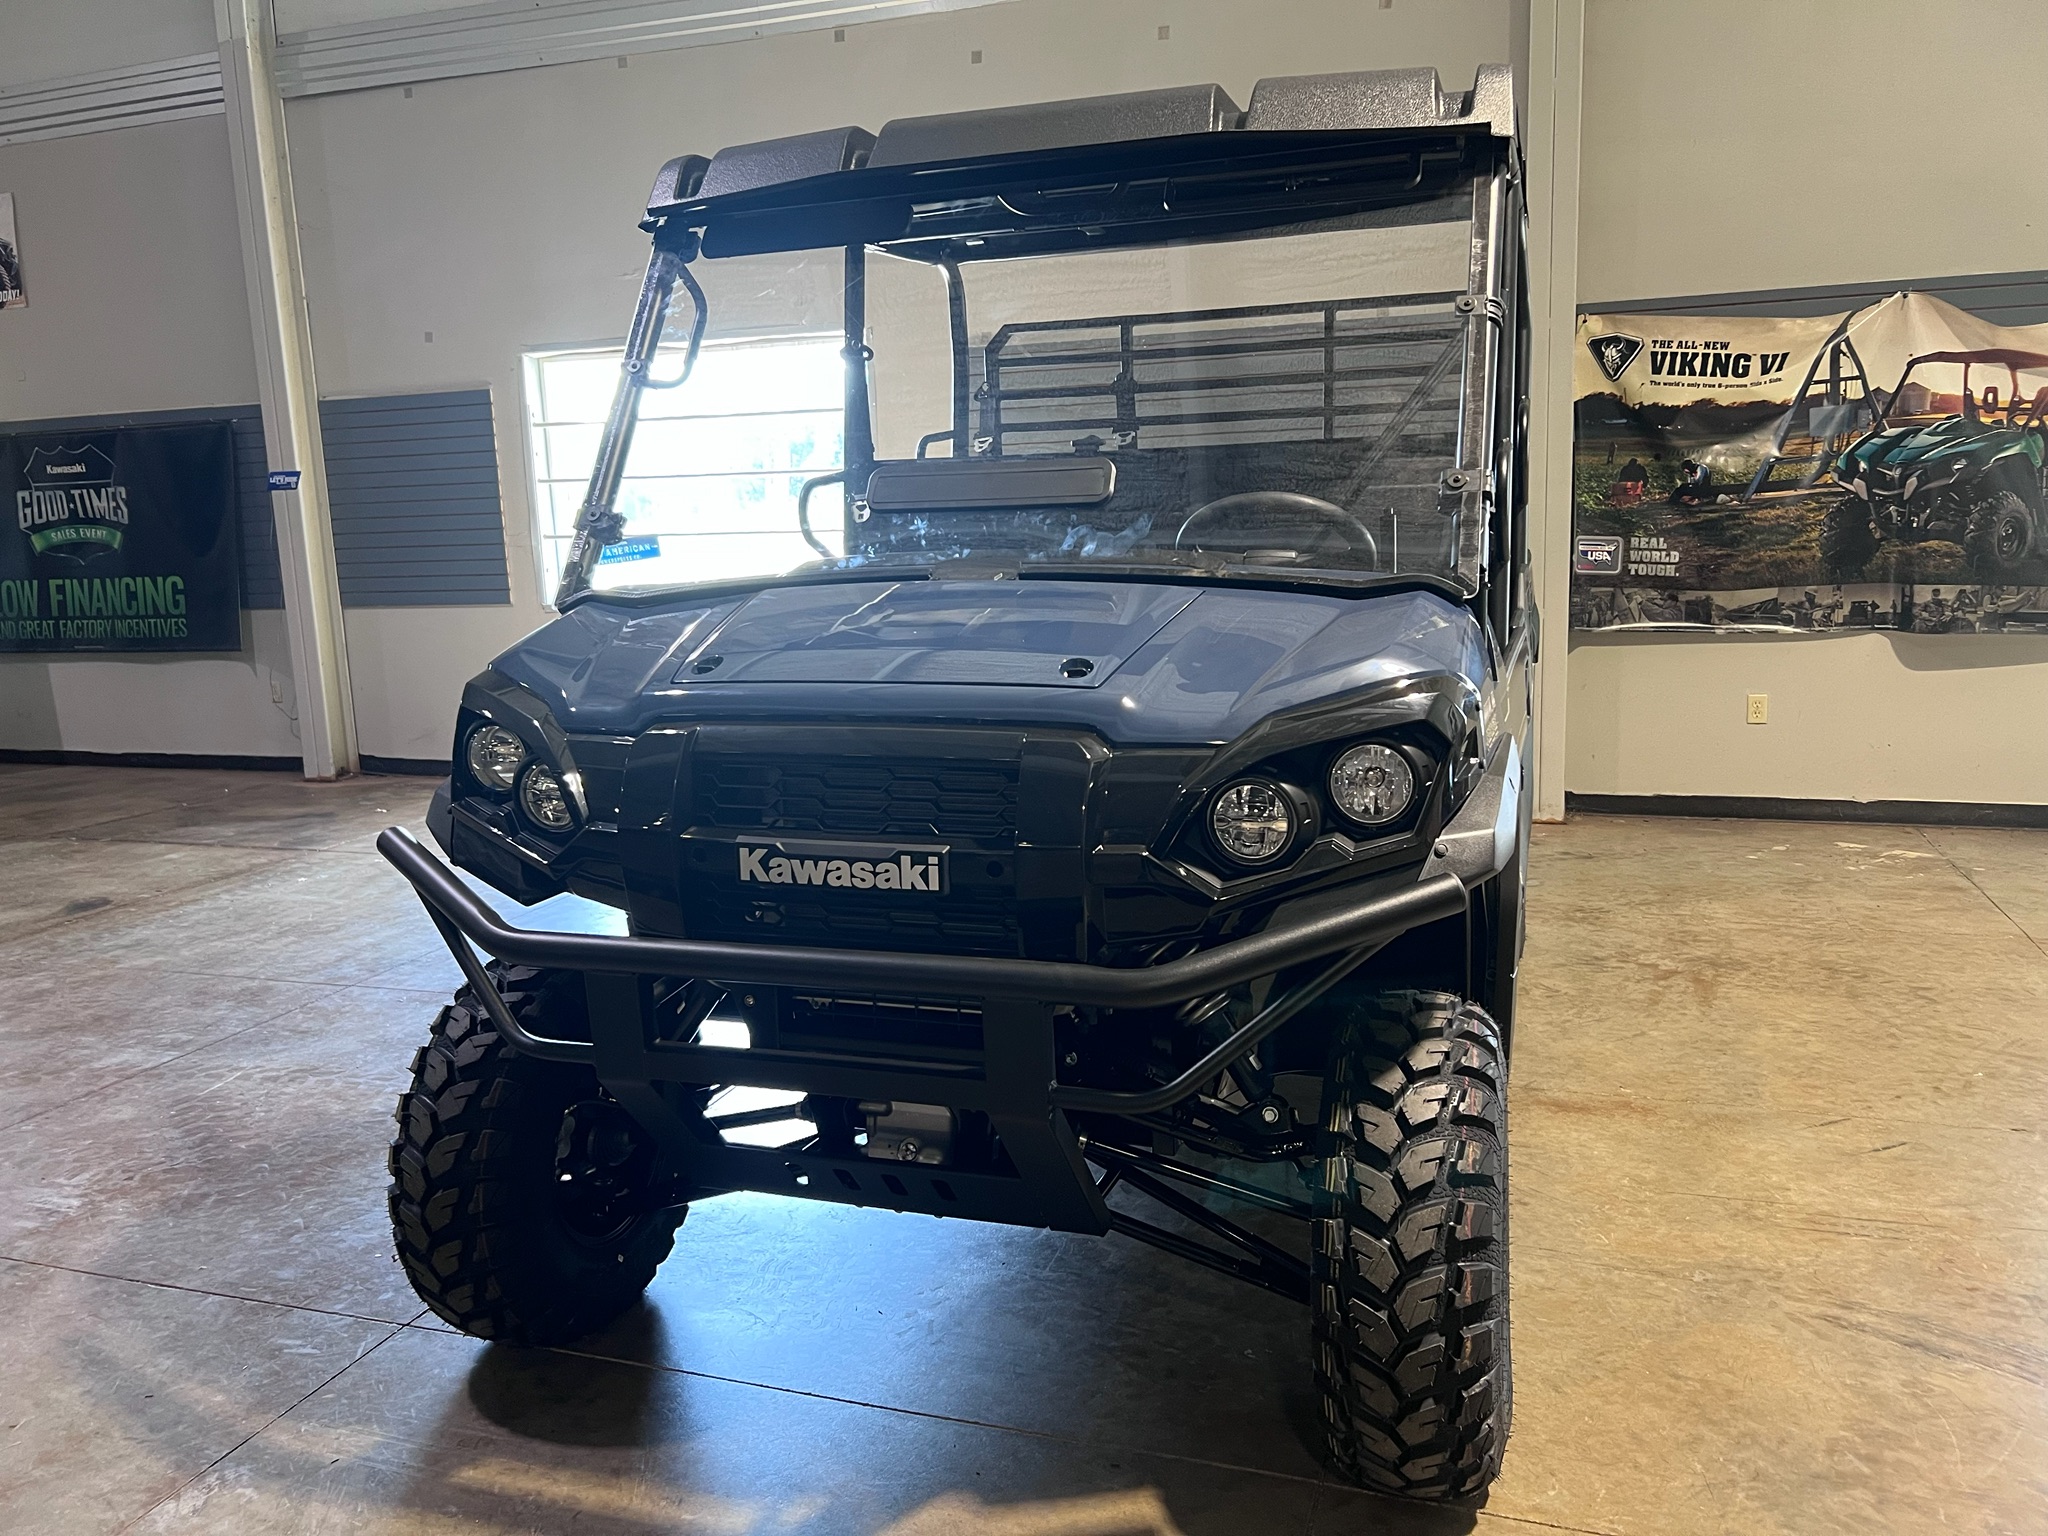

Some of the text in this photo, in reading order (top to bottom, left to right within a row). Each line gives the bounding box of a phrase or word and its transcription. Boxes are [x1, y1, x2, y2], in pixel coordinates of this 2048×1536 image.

[1651, 340, 1730, 350] THE ALL-NEW
[1650, 351, 1752, 379] VIKING
[46, 463, 86, 474] Kawasaki
[17, 487, 128, 529] GOOD TIMES
[51, 528, 106, 541] SALES EVENT
[1630, 538, 1667, 549] REAL
[605, 544, 651, 556] AMERICAN
[1587, 551, 1612, 561] USA
[1629, 551, 1679, 563] WORLD
[1628, 565, 1679, 576] TOUGH.
[0, 576, 186, 618] OW FINANCING
[0, 618, 188, 640] ND GREAT FACTORY INCENTIVES
[739, 847, 940, 891] Kawasaki
